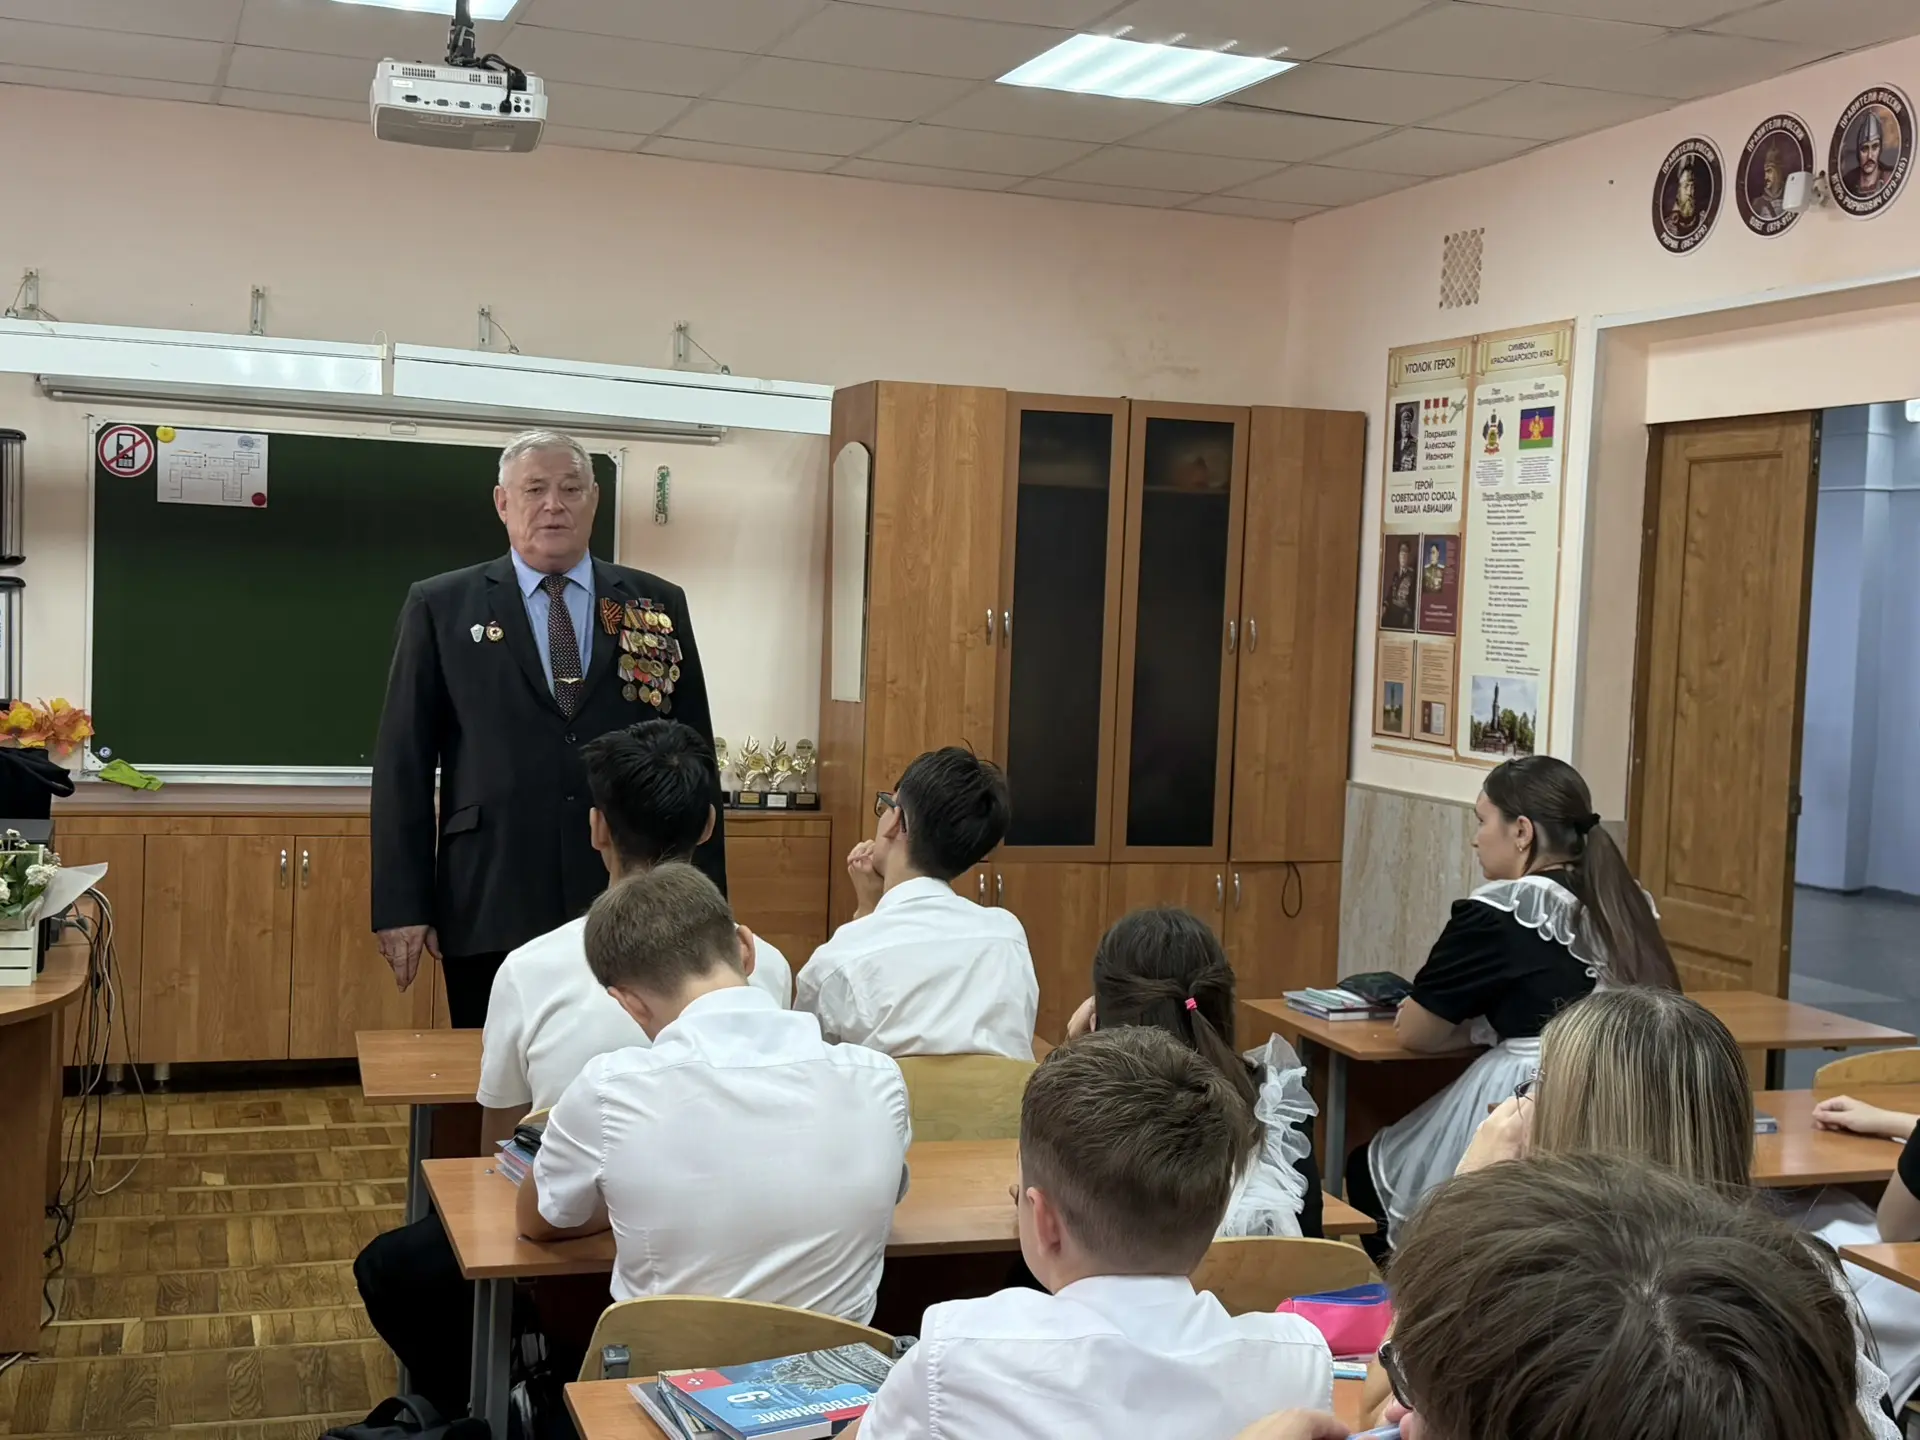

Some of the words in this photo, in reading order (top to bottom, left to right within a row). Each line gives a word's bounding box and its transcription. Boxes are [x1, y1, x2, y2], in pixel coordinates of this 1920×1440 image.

[1839, 91, 1877, 129] ПРАВИТЕЛИ
[1878, 91, 1902, 114] РОССИИ
[1746, 118, 1781, 152] ПРАВИТЕЛИ
[1782, 118, 1805, 141] РОССИИ
[1508, 341, 1536, 352] СИМВОЛЫ
[1490, 351, 1539, 365] КРАСНОДАРСКОГО
[1405, 360, 1433, 374] УГОЛОК
[1433, 357, 1456, 371] ГЕРОЯ
[1424, 441, 1456, 451] Александр
[1425, 452, 1454, 461] Иванович
[1414, 478, 1434, 490] ГЕРОЙ
[1391, 492, 1430, 503] СОВЕТСКОГО
[1394, 504, 1421, 514] МАРШАЛ
[1422, 503, 1453, 514] АВИАЦИИ
[751, 1393, 877, 1424] ЕСТВОЗНАНИЕ
